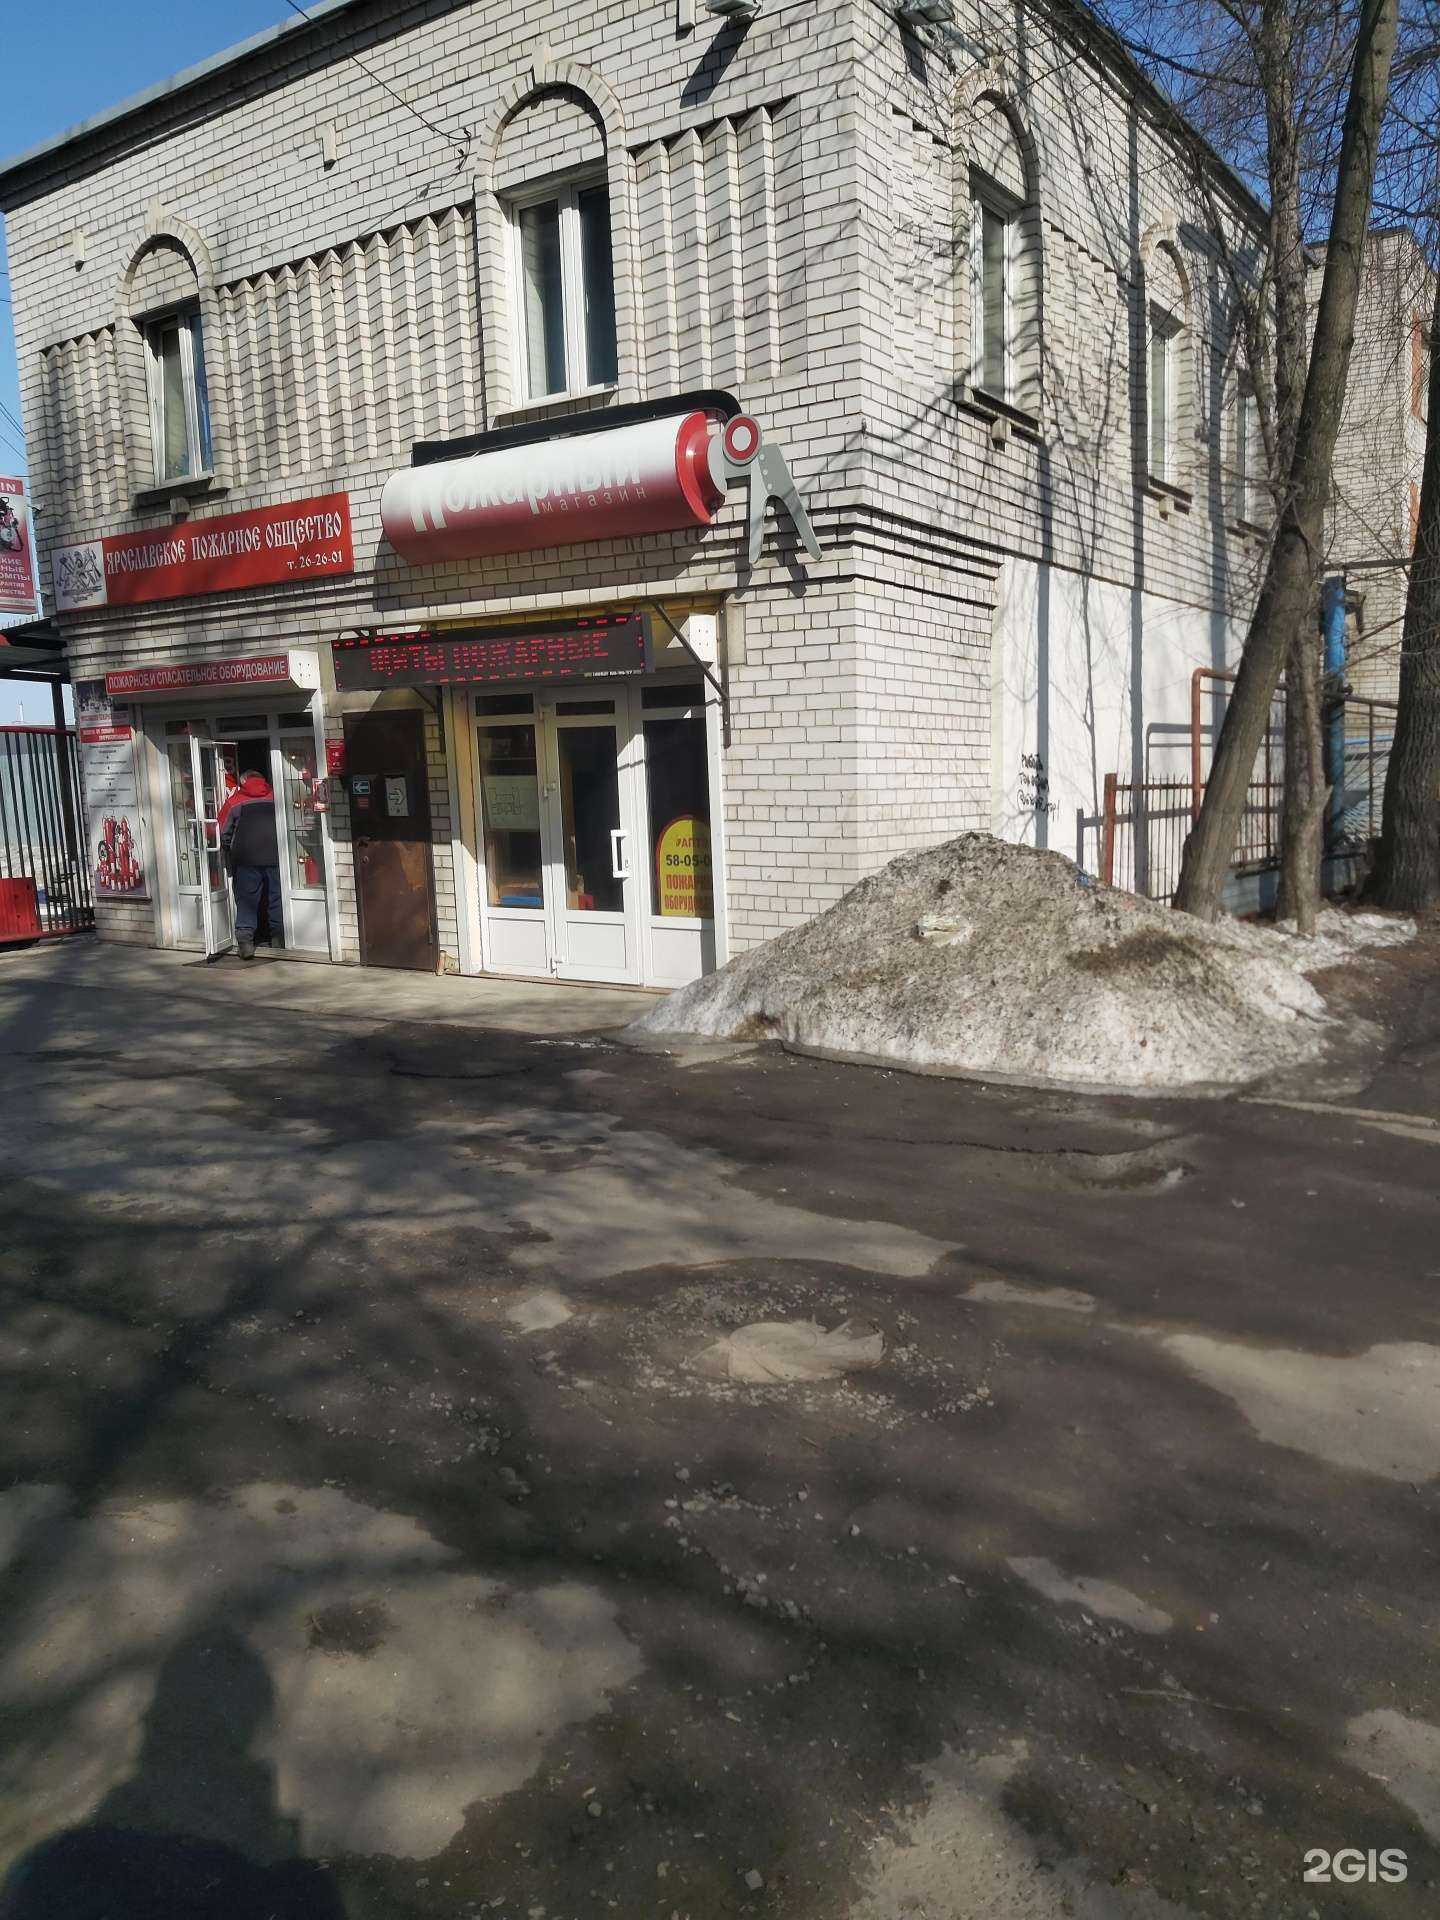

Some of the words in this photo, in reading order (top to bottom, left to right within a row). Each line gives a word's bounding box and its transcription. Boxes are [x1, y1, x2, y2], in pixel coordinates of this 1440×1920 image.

[541, 487, 648, 514] магазин
[106, 539, 186, 575] ЯРОСЛАВСКОЕ
[191, 526, 261, 561] ПОЖАРНОЕ
[265, 511, 343, 551] ОБЩЕСТВО
[299, 550, 344, 569] 26-26-01
[108, 674, 150, 689] ПОЖАРНОЕ
[151, 673, 156, 686] И
[156, 667, 218, 685] СПАСАТЕЛЬНОЕ
[219, 660, 286, 680] ОБОРУДОВАНИЕ
